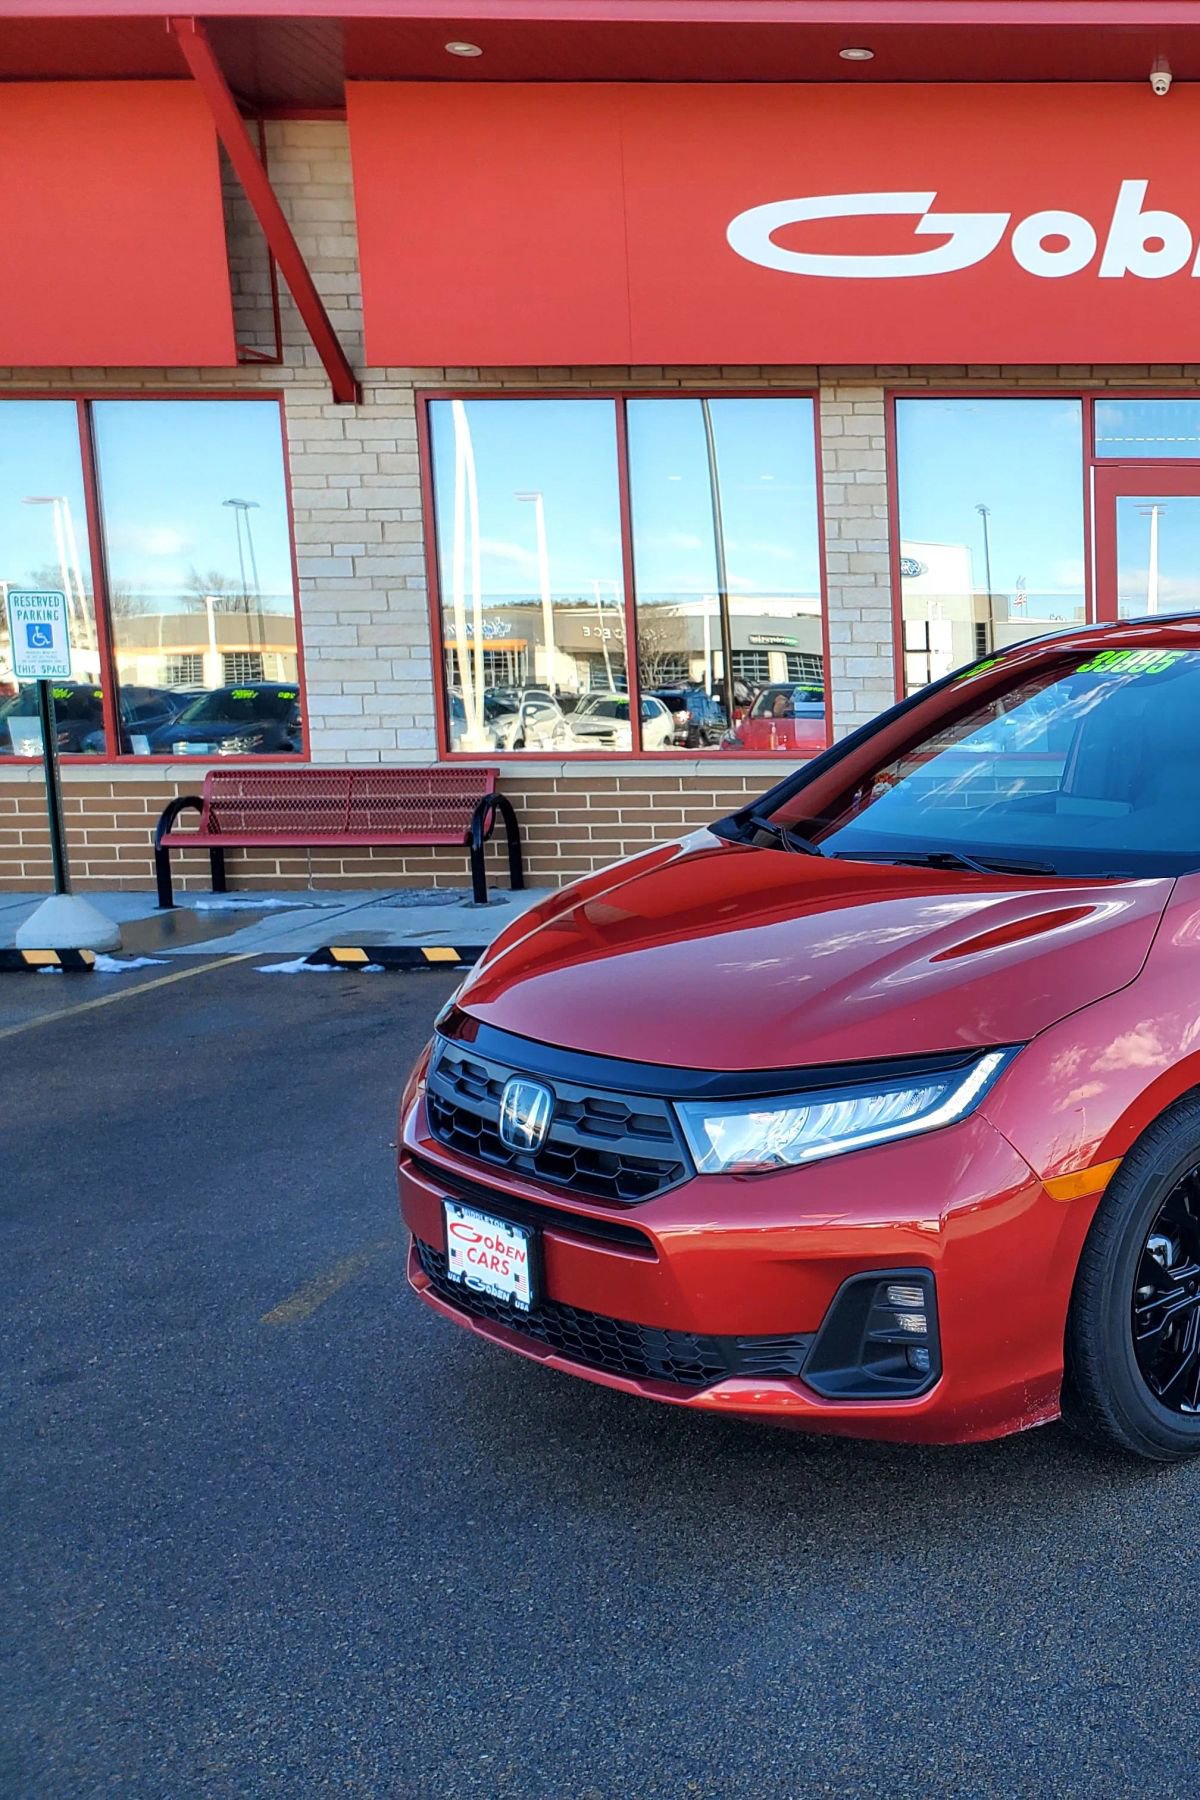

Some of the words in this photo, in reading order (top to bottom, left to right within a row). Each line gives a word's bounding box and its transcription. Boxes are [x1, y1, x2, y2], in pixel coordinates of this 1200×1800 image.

[14, 595, 60, 608] RESERVED
[17, 609, 59, 621] PARKING
[17, 664, 36, 674] THIS
[41, 664, 67, 674] SPACE
[1076, 649, 1187, 674] 39995
[462, 1207, 506, 1230] MIDDLETON
[466, 1247, 510, 1276] CARS
[447, 1271, 461, 1284] USA
[514, 1300, 530, 1313] USA
